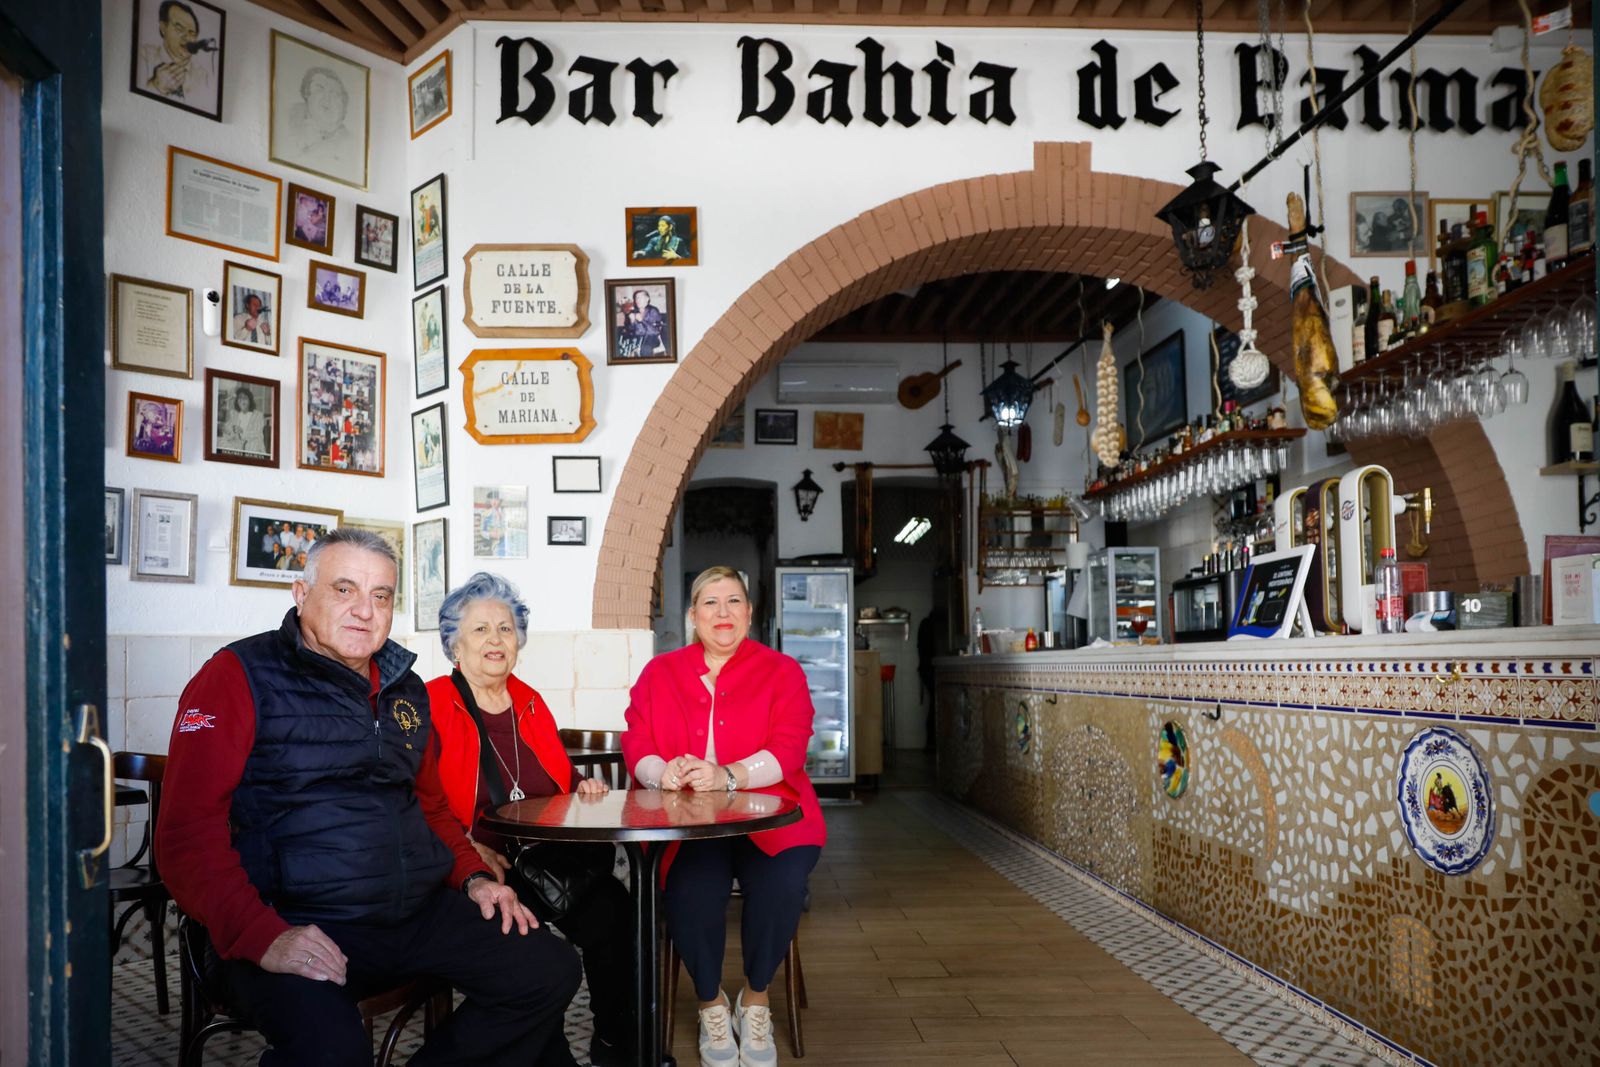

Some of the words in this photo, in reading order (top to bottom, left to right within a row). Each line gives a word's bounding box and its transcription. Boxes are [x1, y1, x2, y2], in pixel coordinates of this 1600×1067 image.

[495, 36, 678, 126] Bar
[1077, 39, 1182, 130] de
[1234, 42, 1540, 135] Palma
[496, 263, 551, 278] CALLE
[503, 283, 521, 294] DE
[526, 283, 544, 294] LA
[501, 371, 550, 385] CALLE
[520, 392, 536, 402] DE
[1461, 598, 1481, 613] 10
